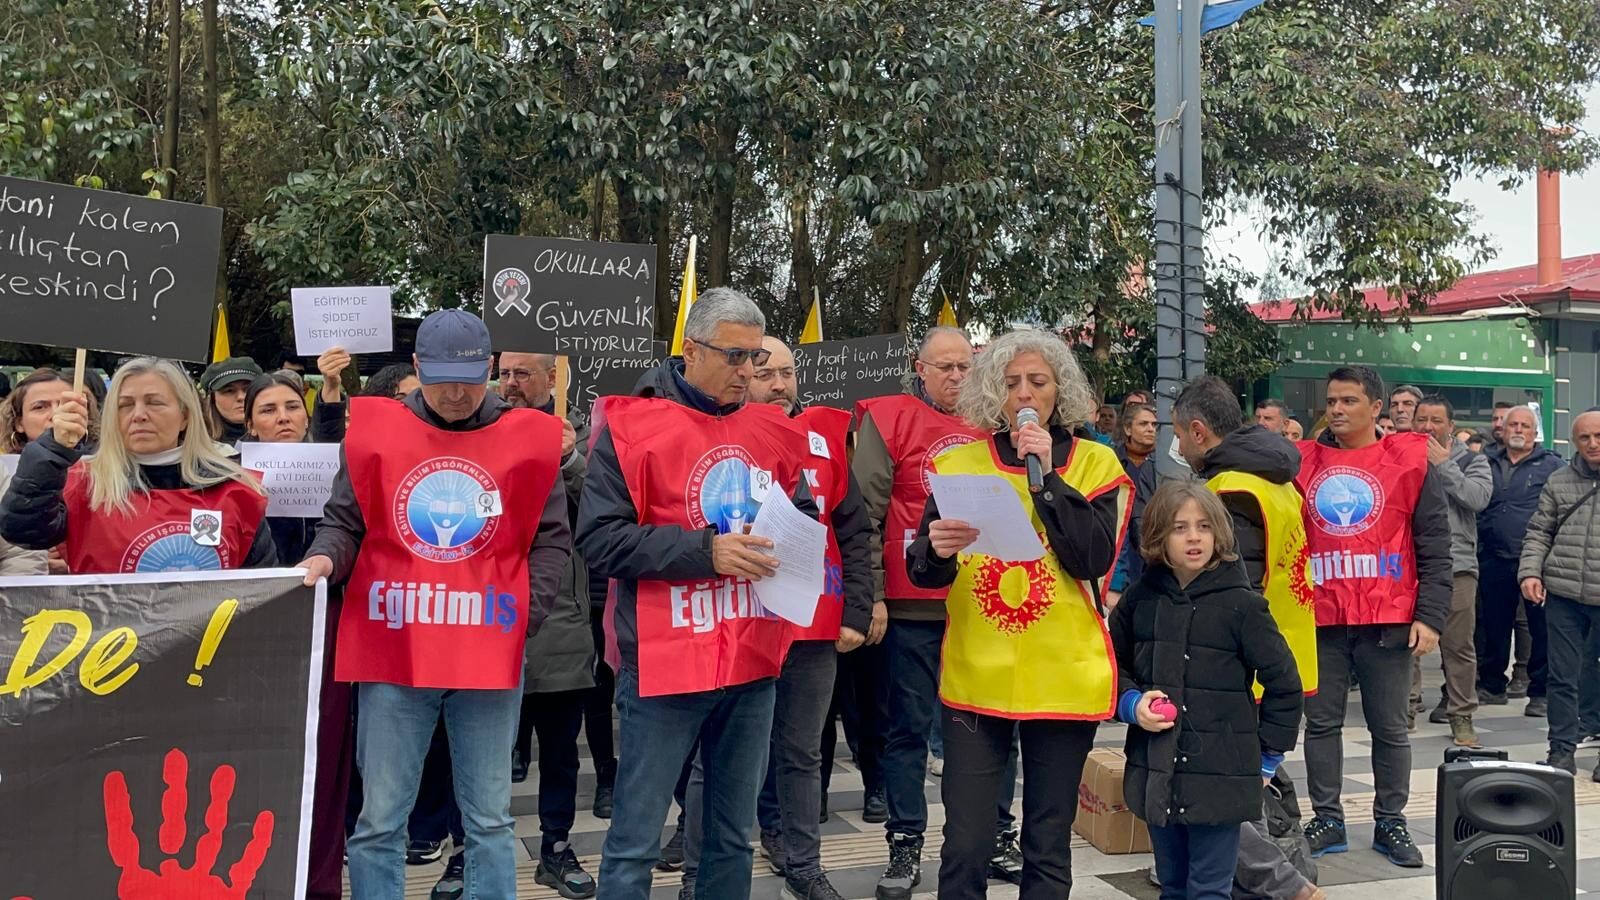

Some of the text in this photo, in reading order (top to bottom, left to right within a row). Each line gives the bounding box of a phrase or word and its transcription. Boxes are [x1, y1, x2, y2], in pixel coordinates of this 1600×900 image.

[0, 225, 130, 271] ılıçtan
[534, 249, 650, 280] OKULLARA
[313, 296, 369, 307] EĞİTİM'DE
[322, 312, 361, 324] ŞİDDET
[536, 296, 653, 331] GÜVENLİK
[308, 327, 378, 339] İSTEMİYORUZ
[815, 367, 848, 384] köle
[255, 461, 324, 470] OKULLARIMIZ
[276, 472, 324, 482] EVİ DEĞİL
[400, 488, 409, 500] VE
[406, 466, 430, 488] BİLİM
[431, 460, 493, 489] İŞGÖRENLERİ
[267, 486, 330, 496] AŞAMA SEVİN
[690, 485, 699, 498] VE
[135, 534, 157, 556] BİLİM
